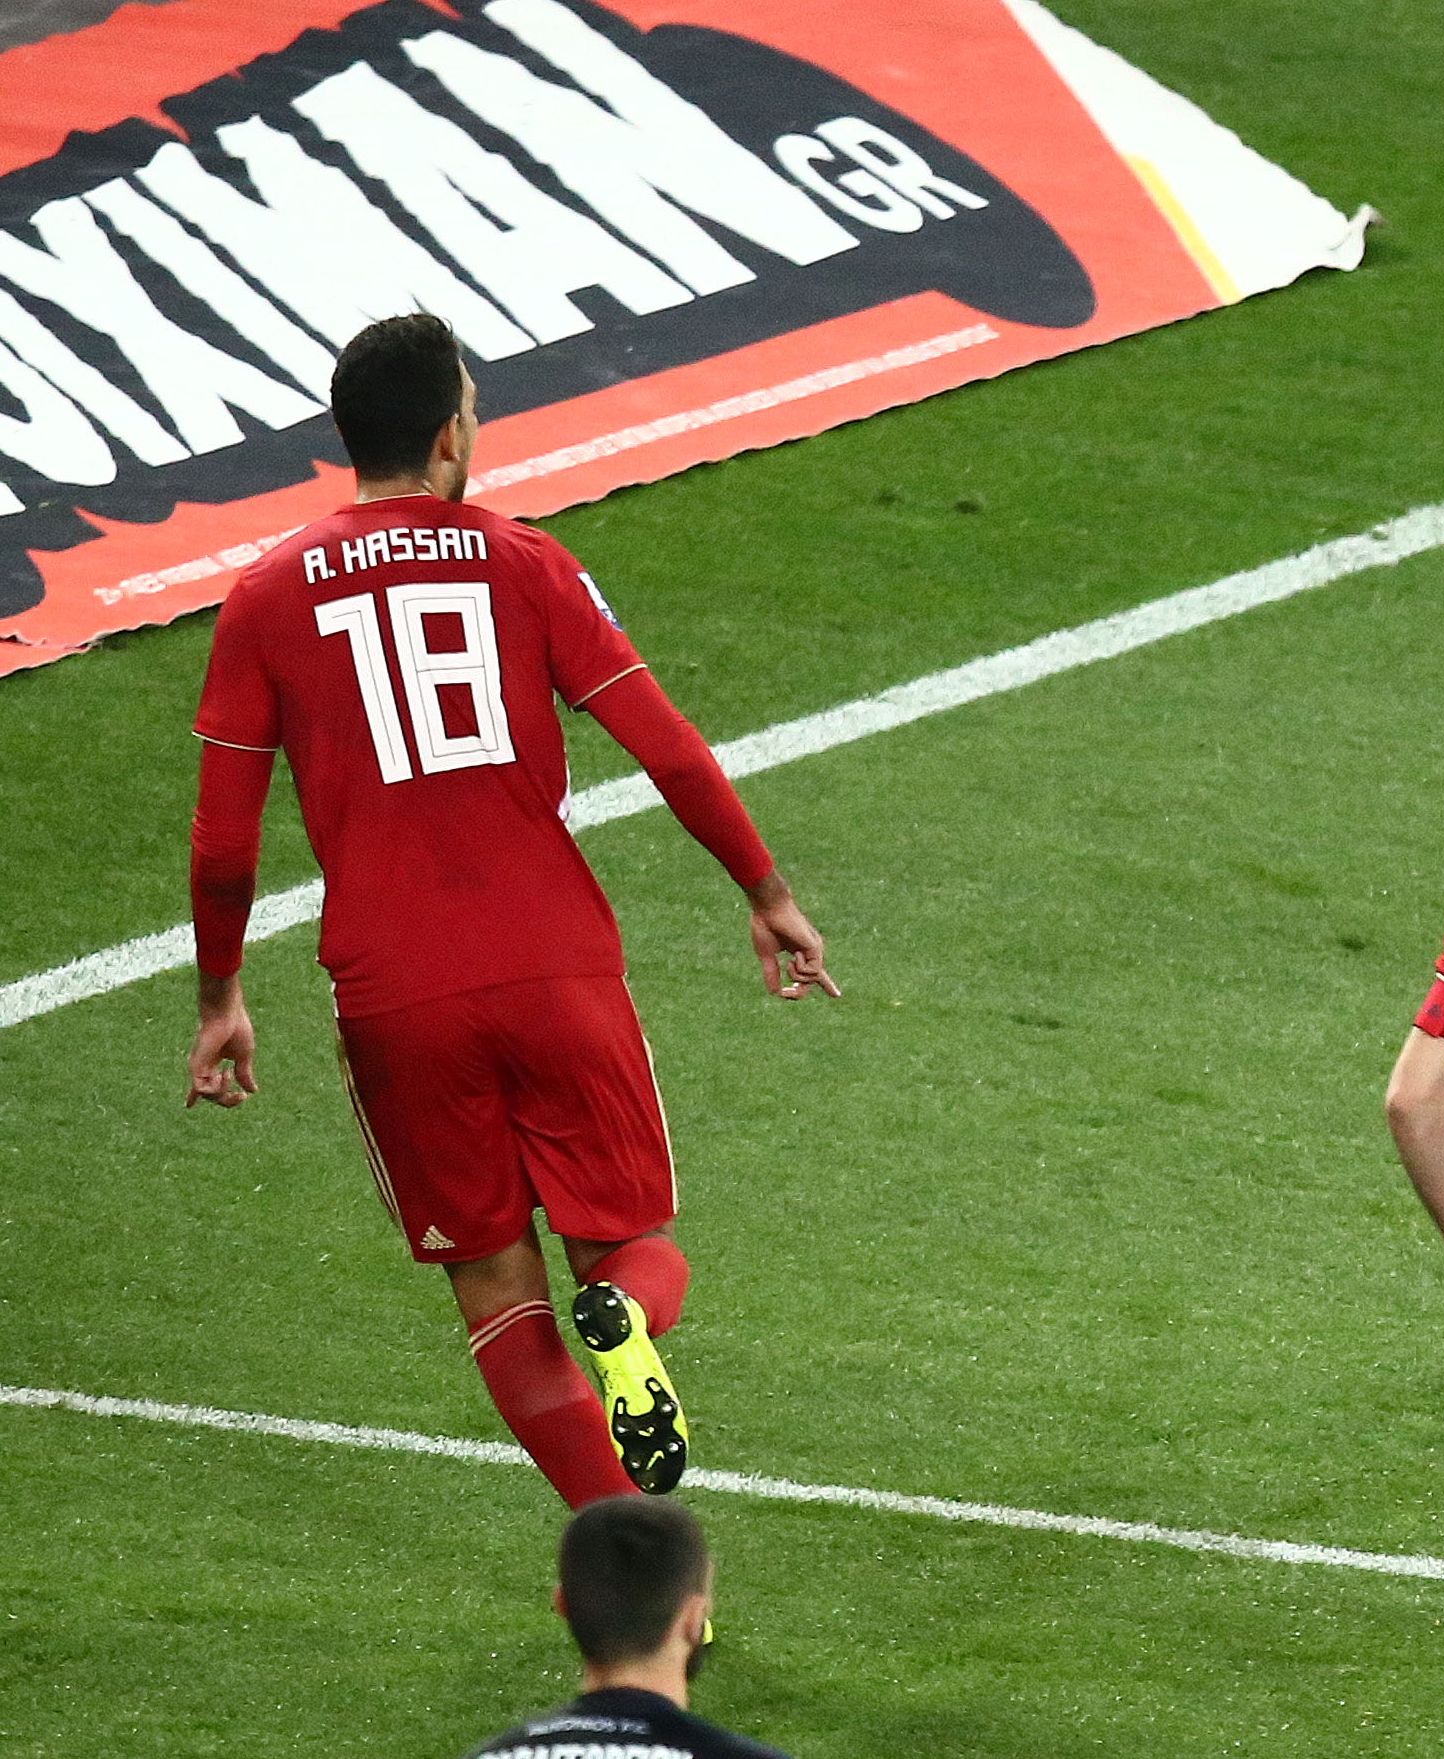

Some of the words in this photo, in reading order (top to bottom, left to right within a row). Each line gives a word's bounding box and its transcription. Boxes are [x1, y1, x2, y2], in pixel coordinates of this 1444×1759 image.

[772, 116, 989, 233] GR
[303, 546, 336, 584] A.
[341, 528, 488, 573] HASSAN
[313, 582, 516, 785] 18
